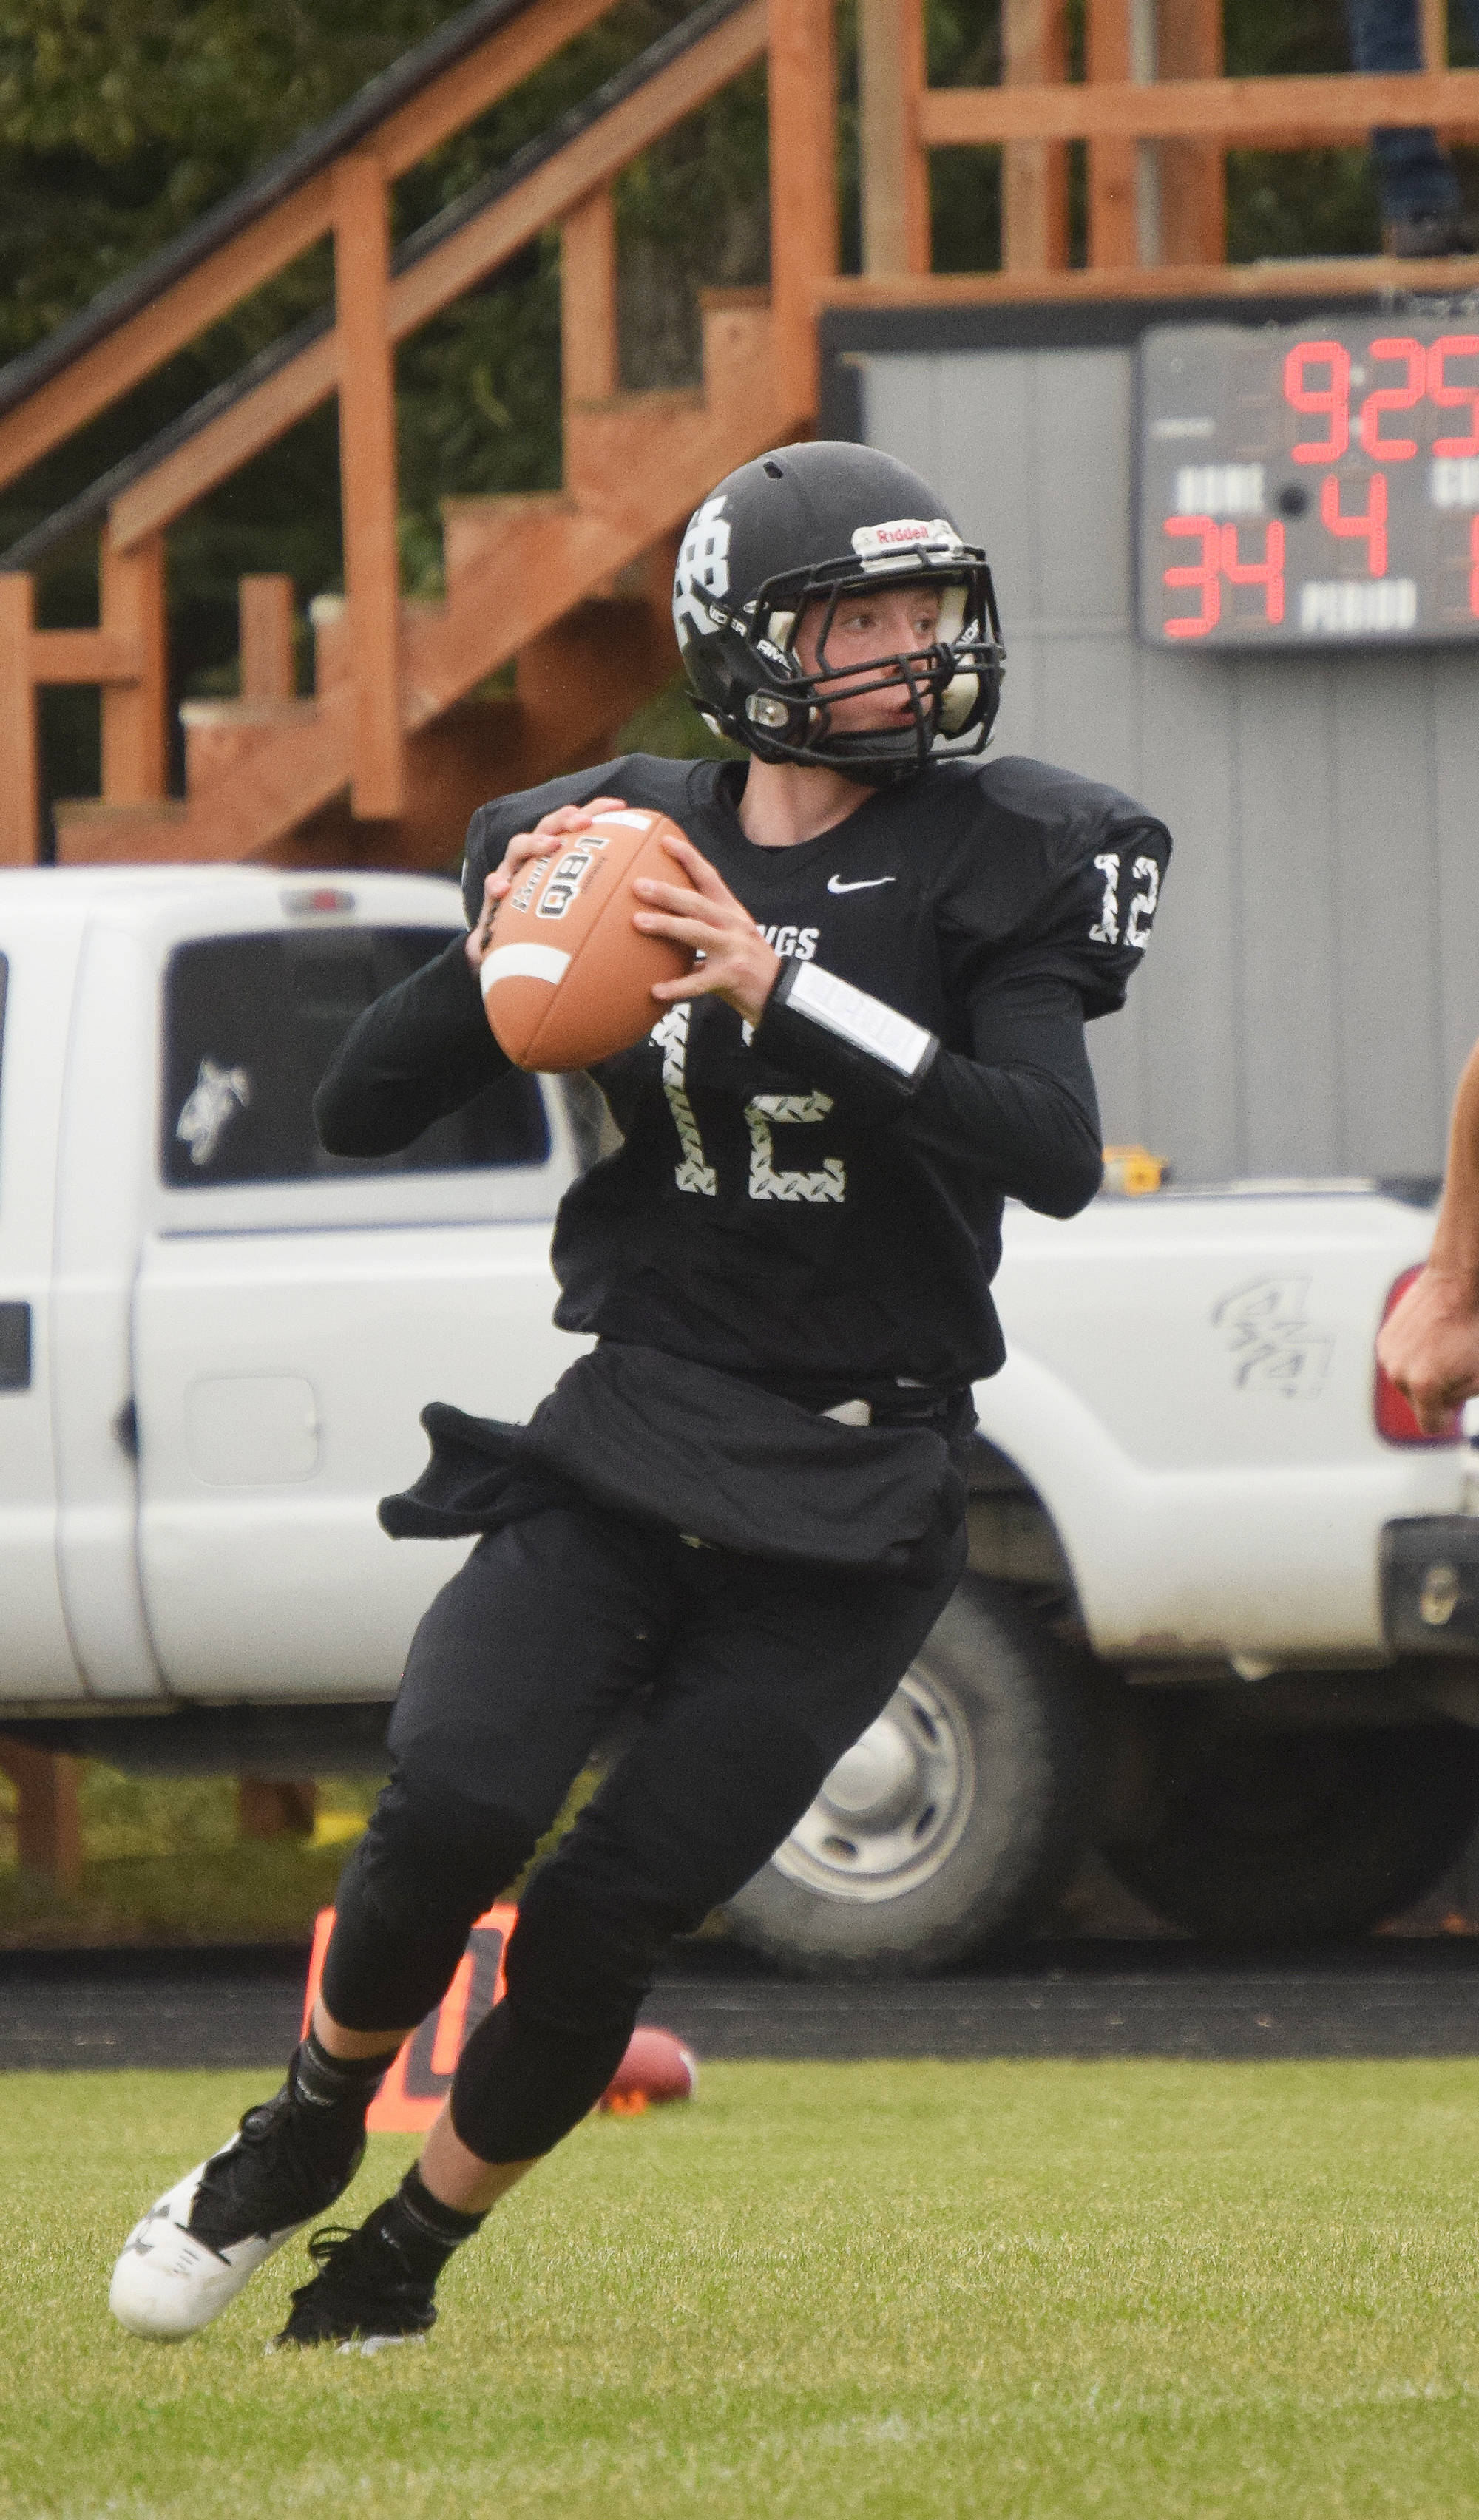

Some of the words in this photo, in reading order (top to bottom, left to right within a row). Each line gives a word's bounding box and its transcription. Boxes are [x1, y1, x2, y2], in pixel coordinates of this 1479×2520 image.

[876, 525, 929, 544] Riddell
[1321, 472, 1387, 578] 4
[1164, 515, 1284, 637] 34
[536, 836, 610, 919] QB1
[1089, 853, 1159, 947] 12
